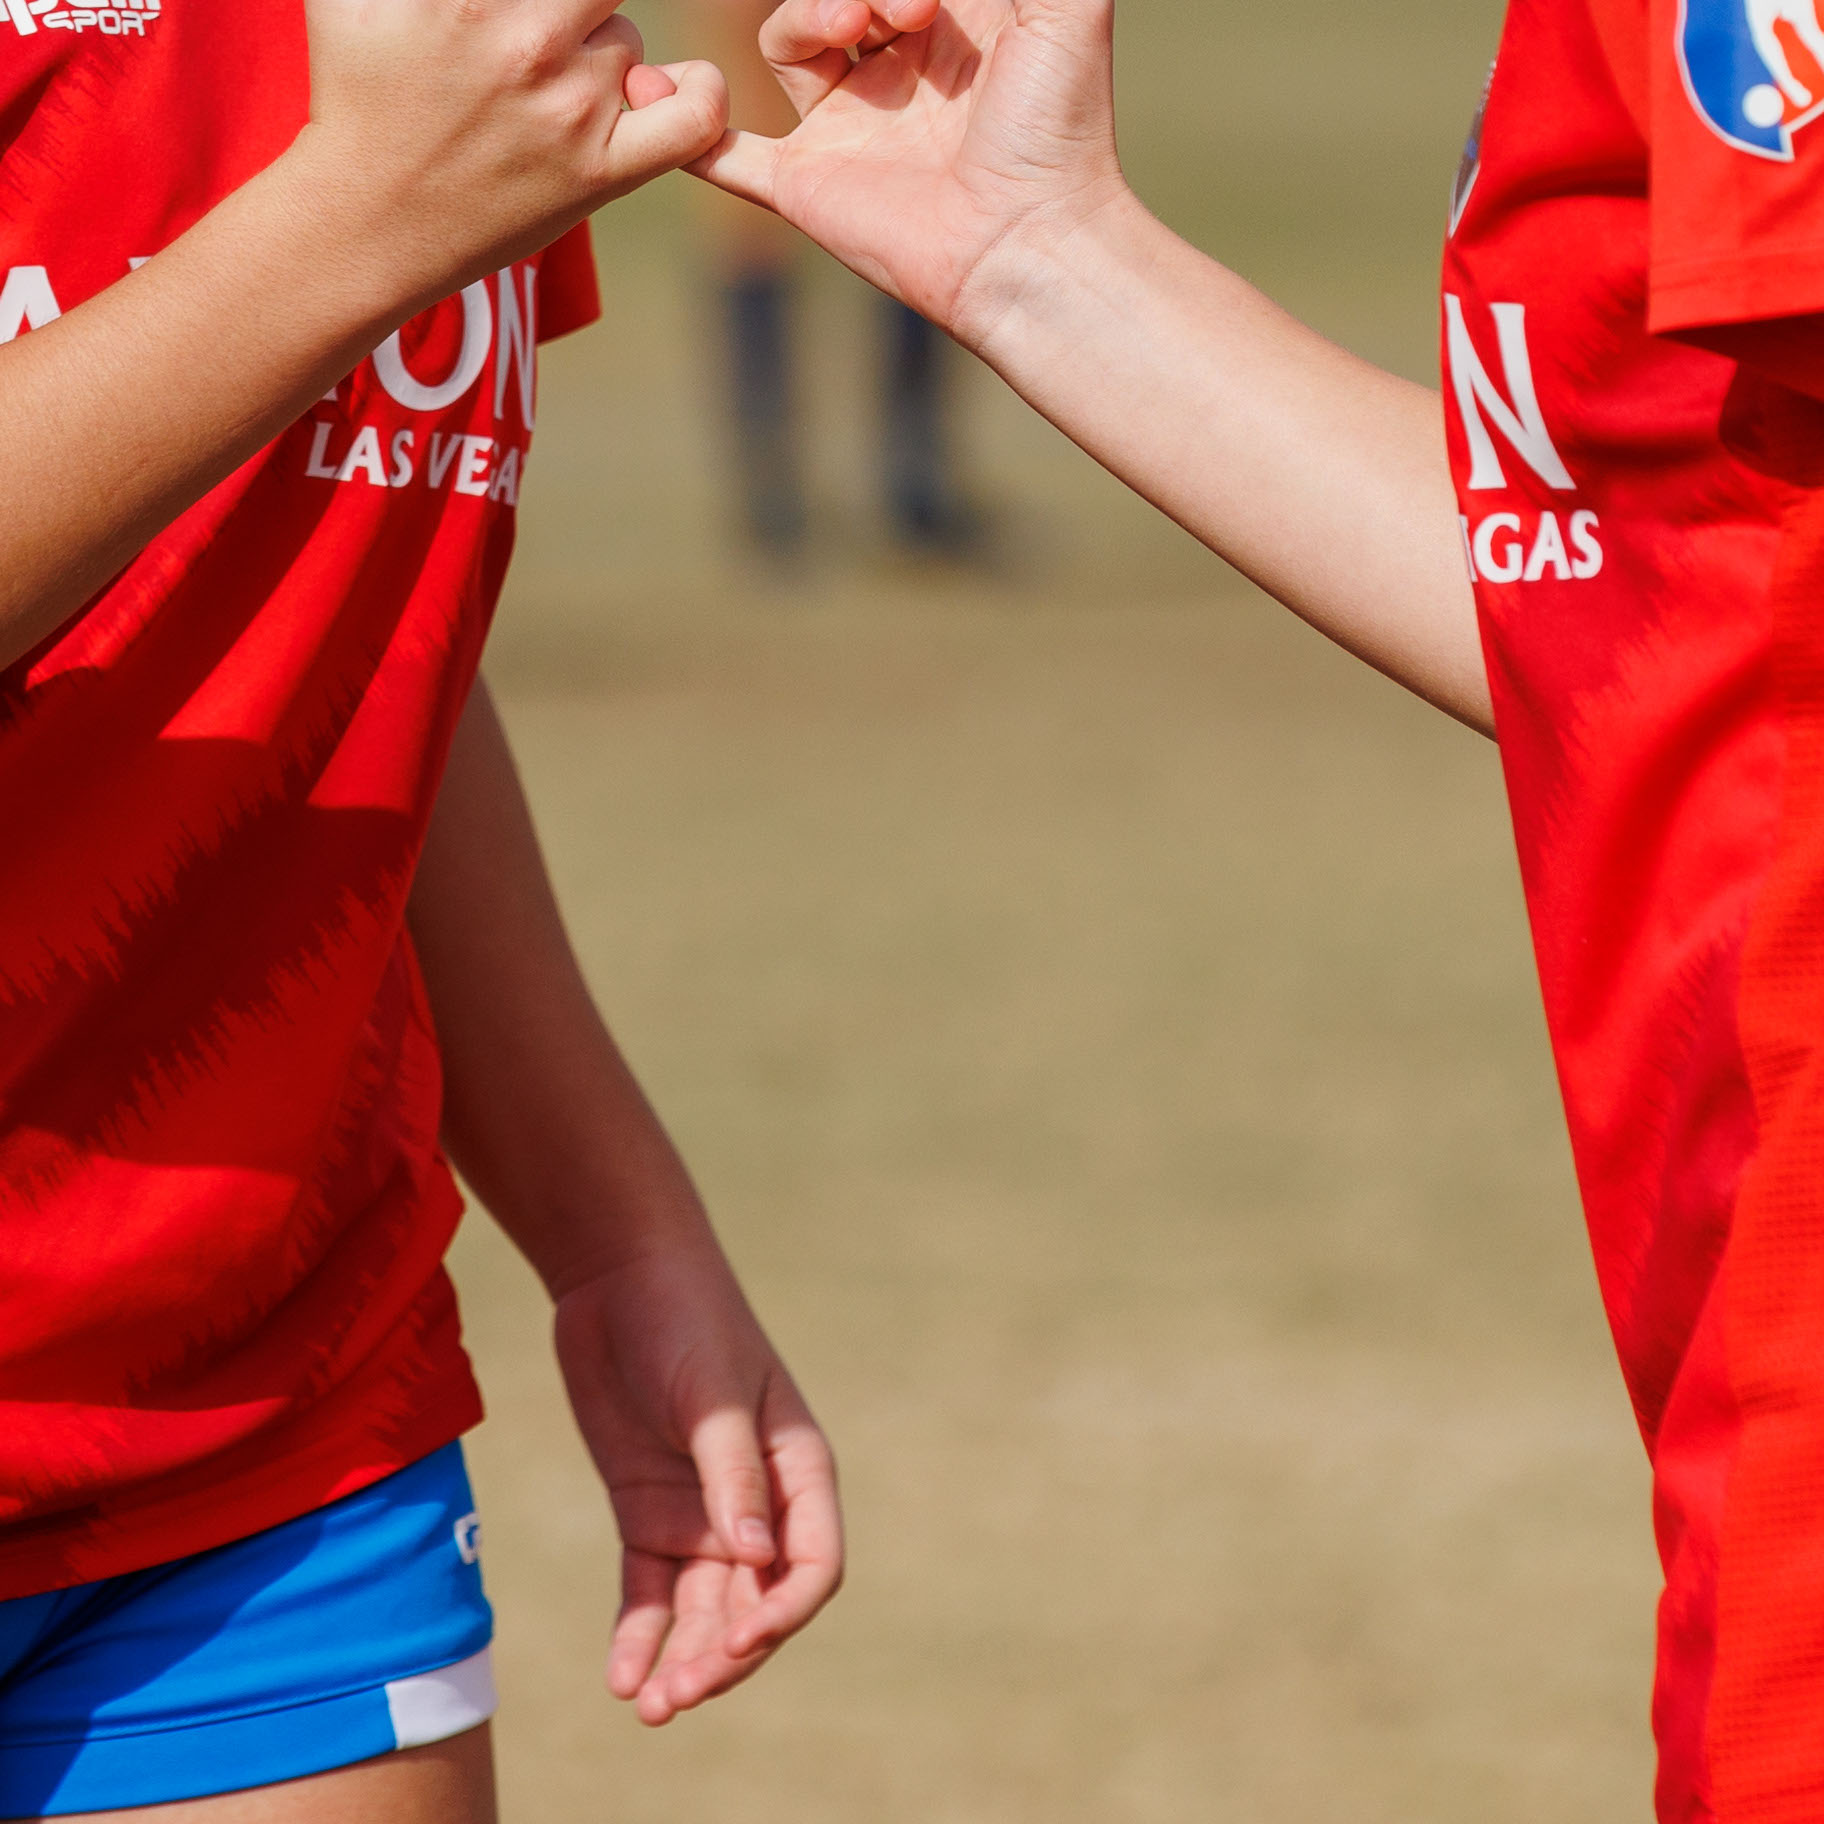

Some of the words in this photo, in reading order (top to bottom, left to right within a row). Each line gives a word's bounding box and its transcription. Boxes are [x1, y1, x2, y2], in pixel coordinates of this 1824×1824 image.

[42, 9, 160, 36] SPORT
[305, 422, 415, 488] LAS
[428, 433, 526, 507] VEA
[1459, 509, 1603, 583] GAS
